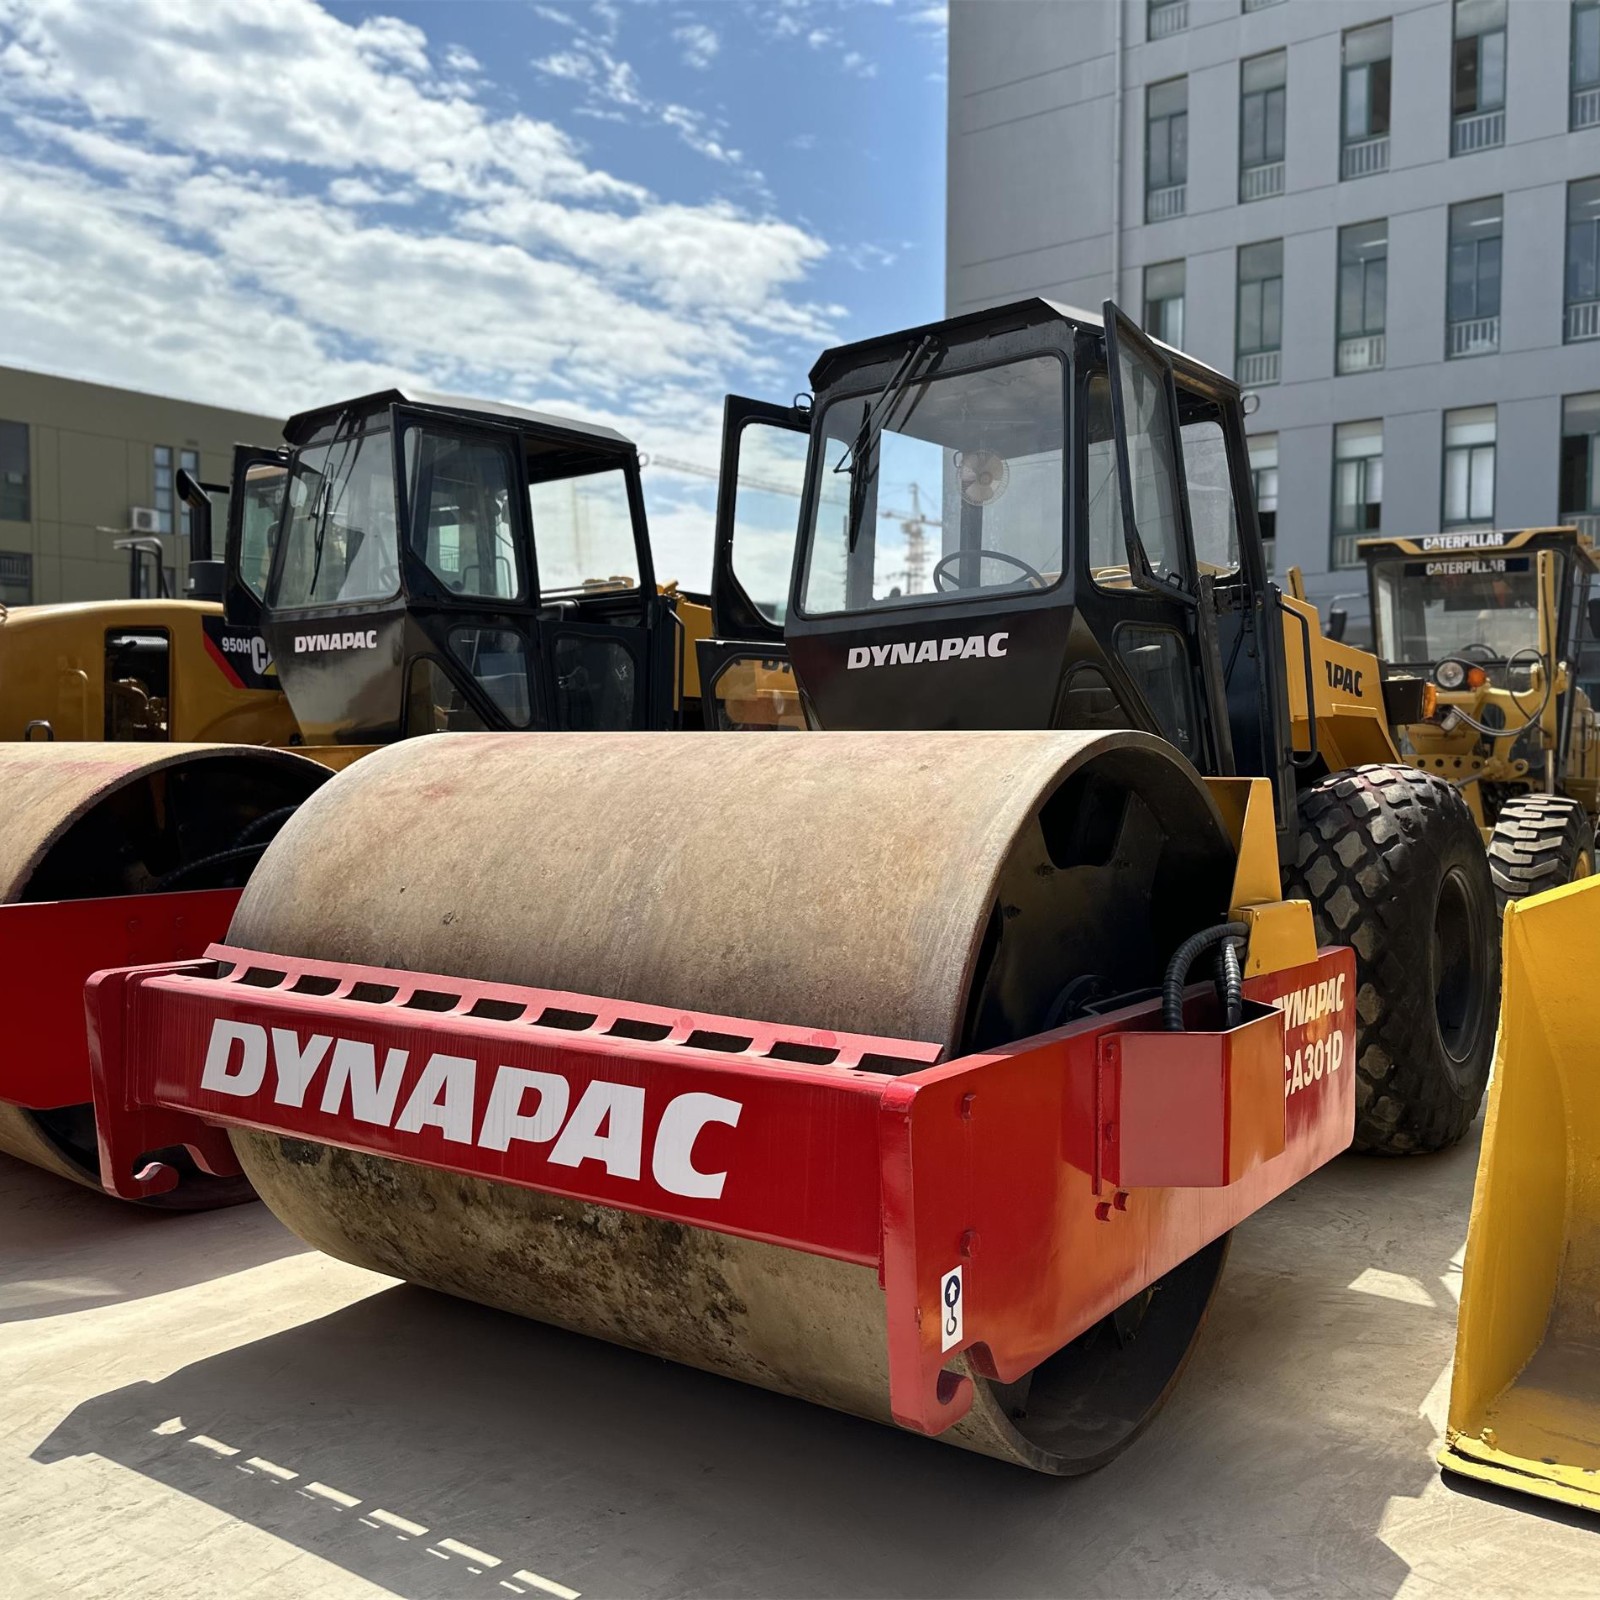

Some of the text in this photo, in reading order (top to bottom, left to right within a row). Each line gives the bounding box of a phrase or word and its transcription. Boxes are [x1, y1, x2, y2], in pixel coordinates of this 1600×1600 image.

[1423, 533, 1504, 550] CATERPILLAR
[222, 637, 251, 653] 950H
[294, 630, 377, 653] DYNAPAC
[847, 632, 1009, 670] DYNAPAC
[200, 1018, 743, 1200] DYNAPAC
